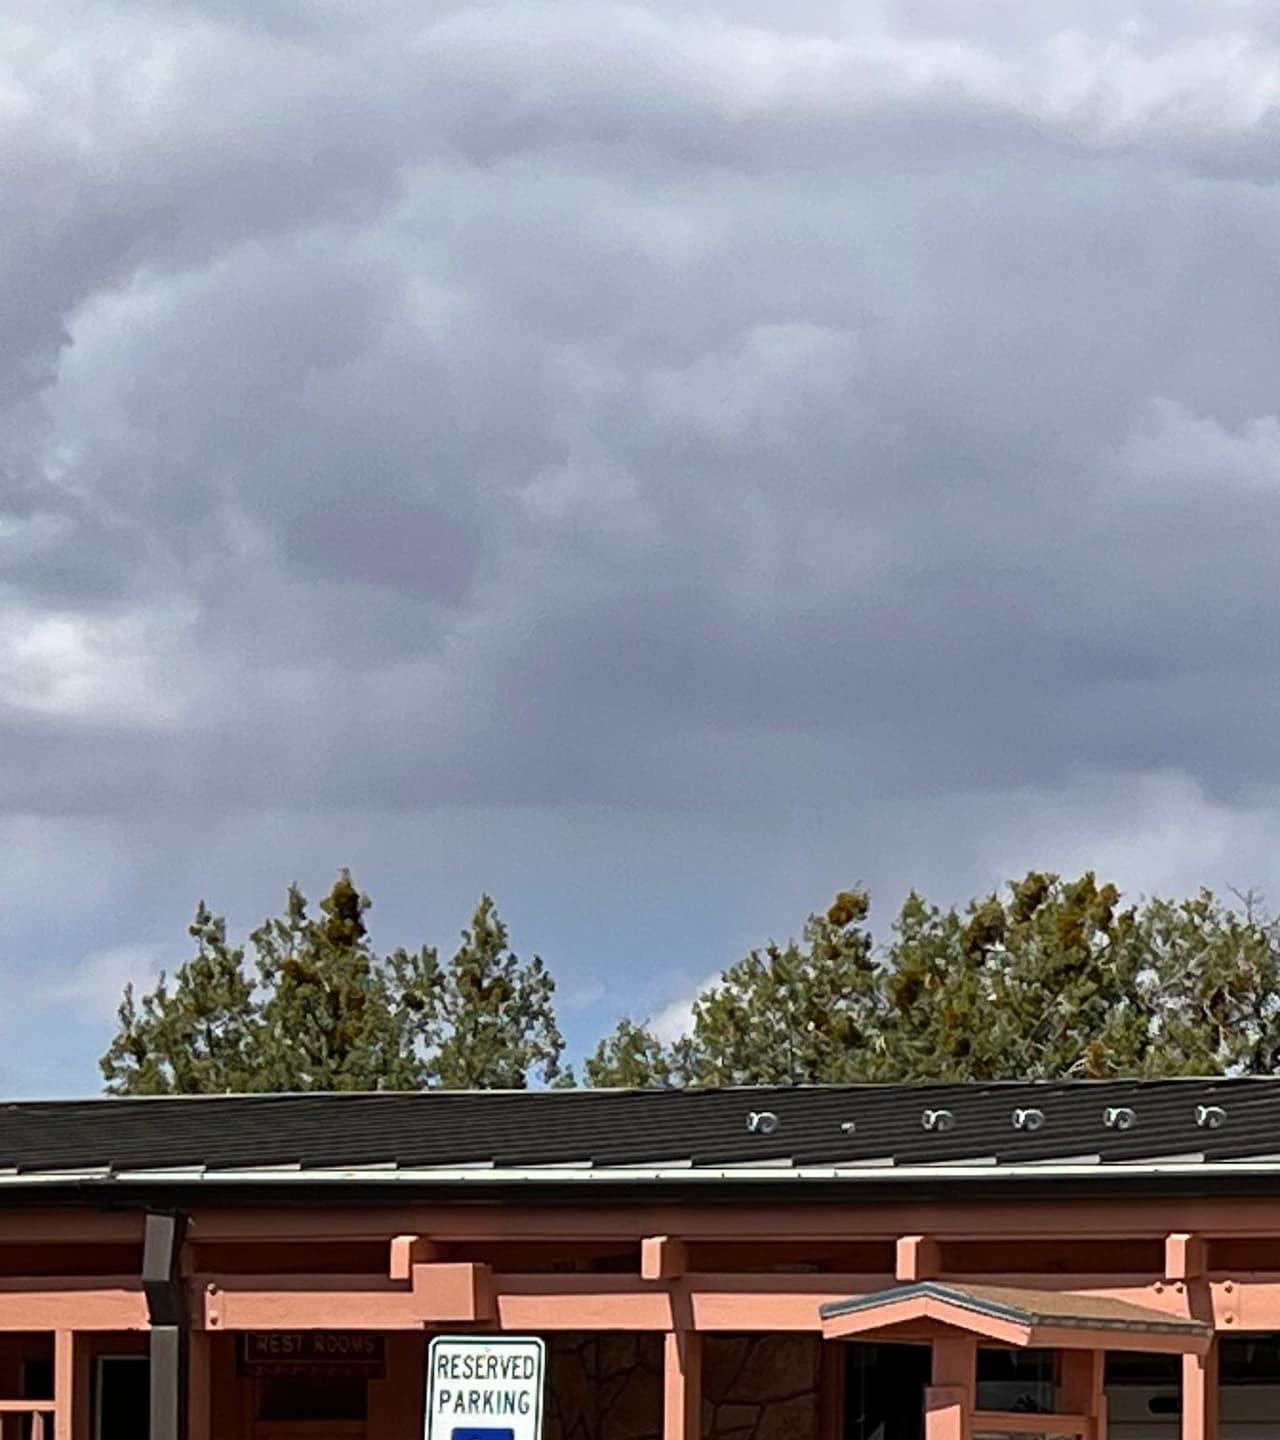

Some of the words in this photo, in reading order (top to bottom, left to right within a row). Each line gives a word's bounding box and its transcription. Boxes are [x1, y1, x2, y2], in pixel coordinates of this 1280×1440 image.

[256, 1334, 304, 1353] REST
[313, 1334, 376, 1354] ROOMS
[437, 1354, 535, 1380] RESERVED
[438, 1389, 531, 1416] PARKING
